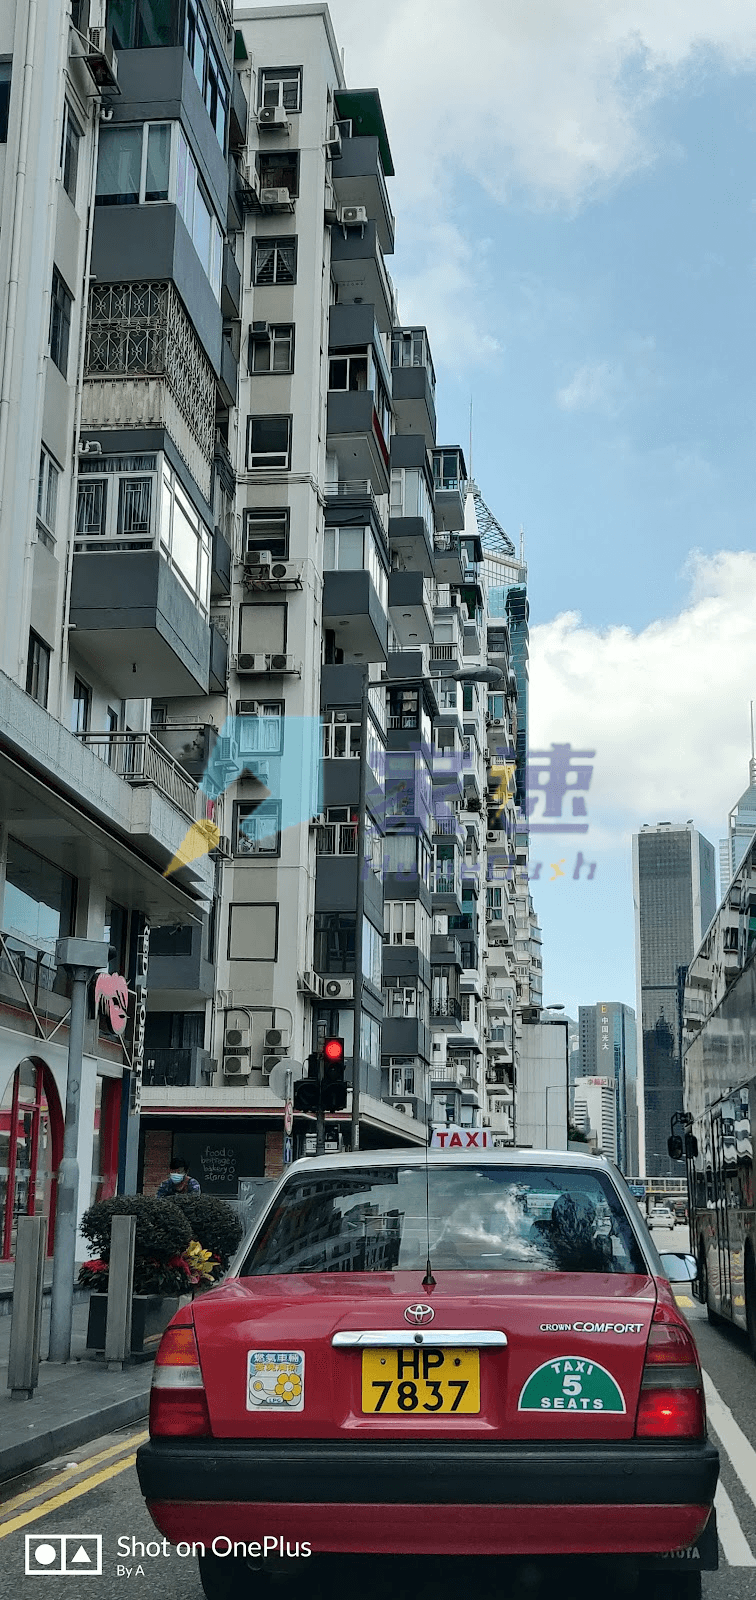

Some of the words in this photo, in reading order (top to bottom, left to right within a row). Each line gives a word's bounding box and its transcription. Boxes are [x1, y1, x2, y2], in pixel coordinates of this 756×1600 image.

[601, 1016, 609, 1050] 中国光大
[436, 1131, 487, 1148] TAXI
[205, 1145, 226, 1157] food
[540, 1323, 572, 1332] CROWN
[572, 1321, 645, 1334] COMFORT
[397, 1349, 445, 1380] HP
[550, 1360, 594, 1376] TAXI
[561, 1374, 583, 1396] 5
[366, 1380, 470, 1412] 7837
[540, 1397, 604, 1409] SEATS
